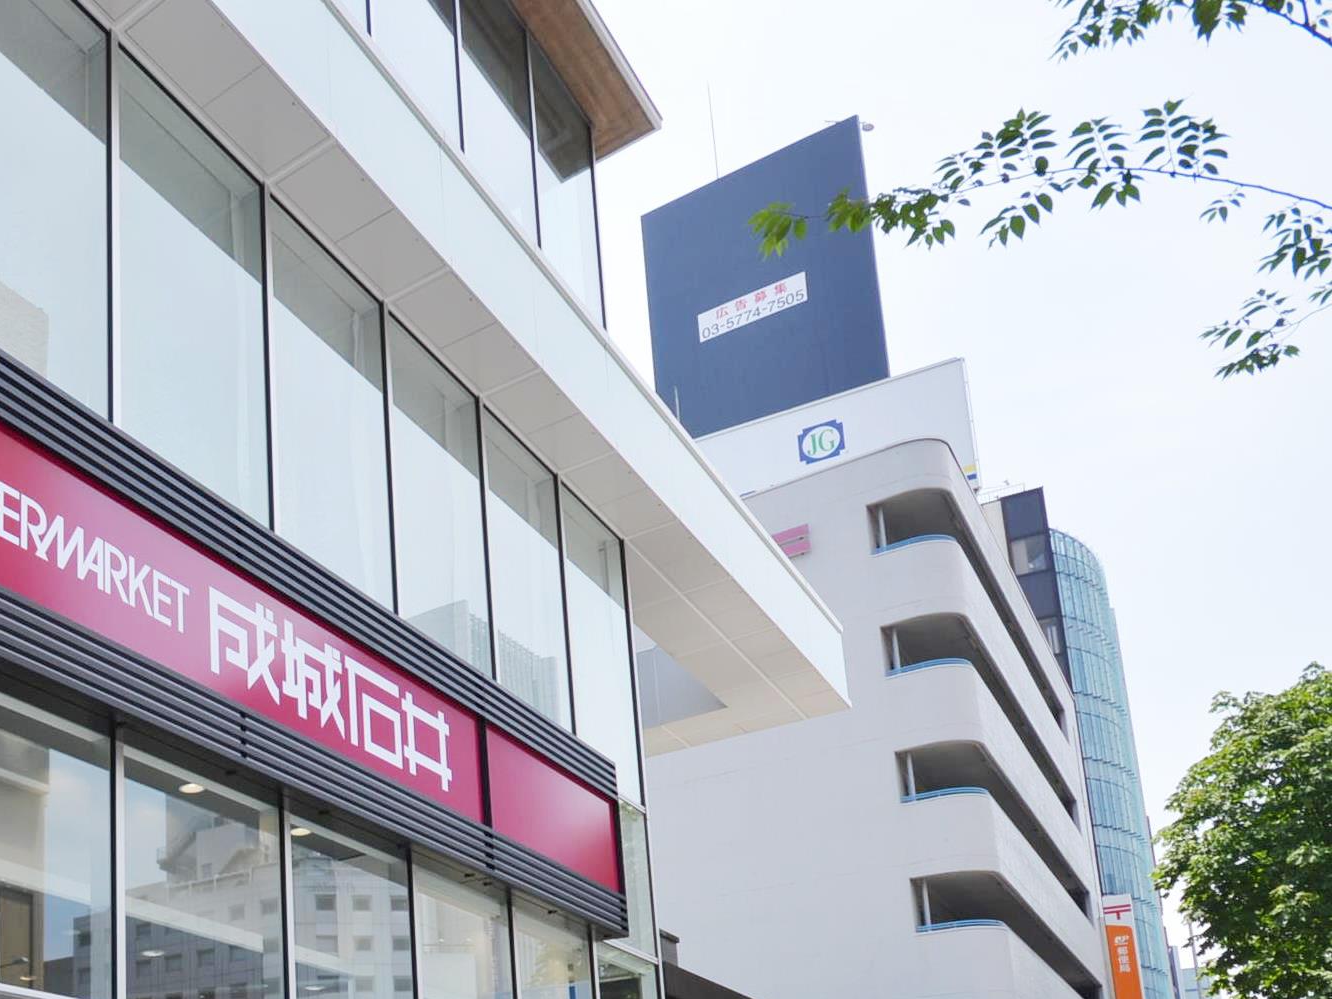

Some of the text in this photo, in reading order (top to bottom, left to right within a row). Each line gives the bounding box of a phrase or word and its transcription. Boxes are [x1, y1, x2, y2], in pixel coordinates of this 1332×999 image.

[702, 289, 805, 339] 03-5774-7505
[807, 429, 835, 456] JG
[209, 585, 453, 792] 成城石井
